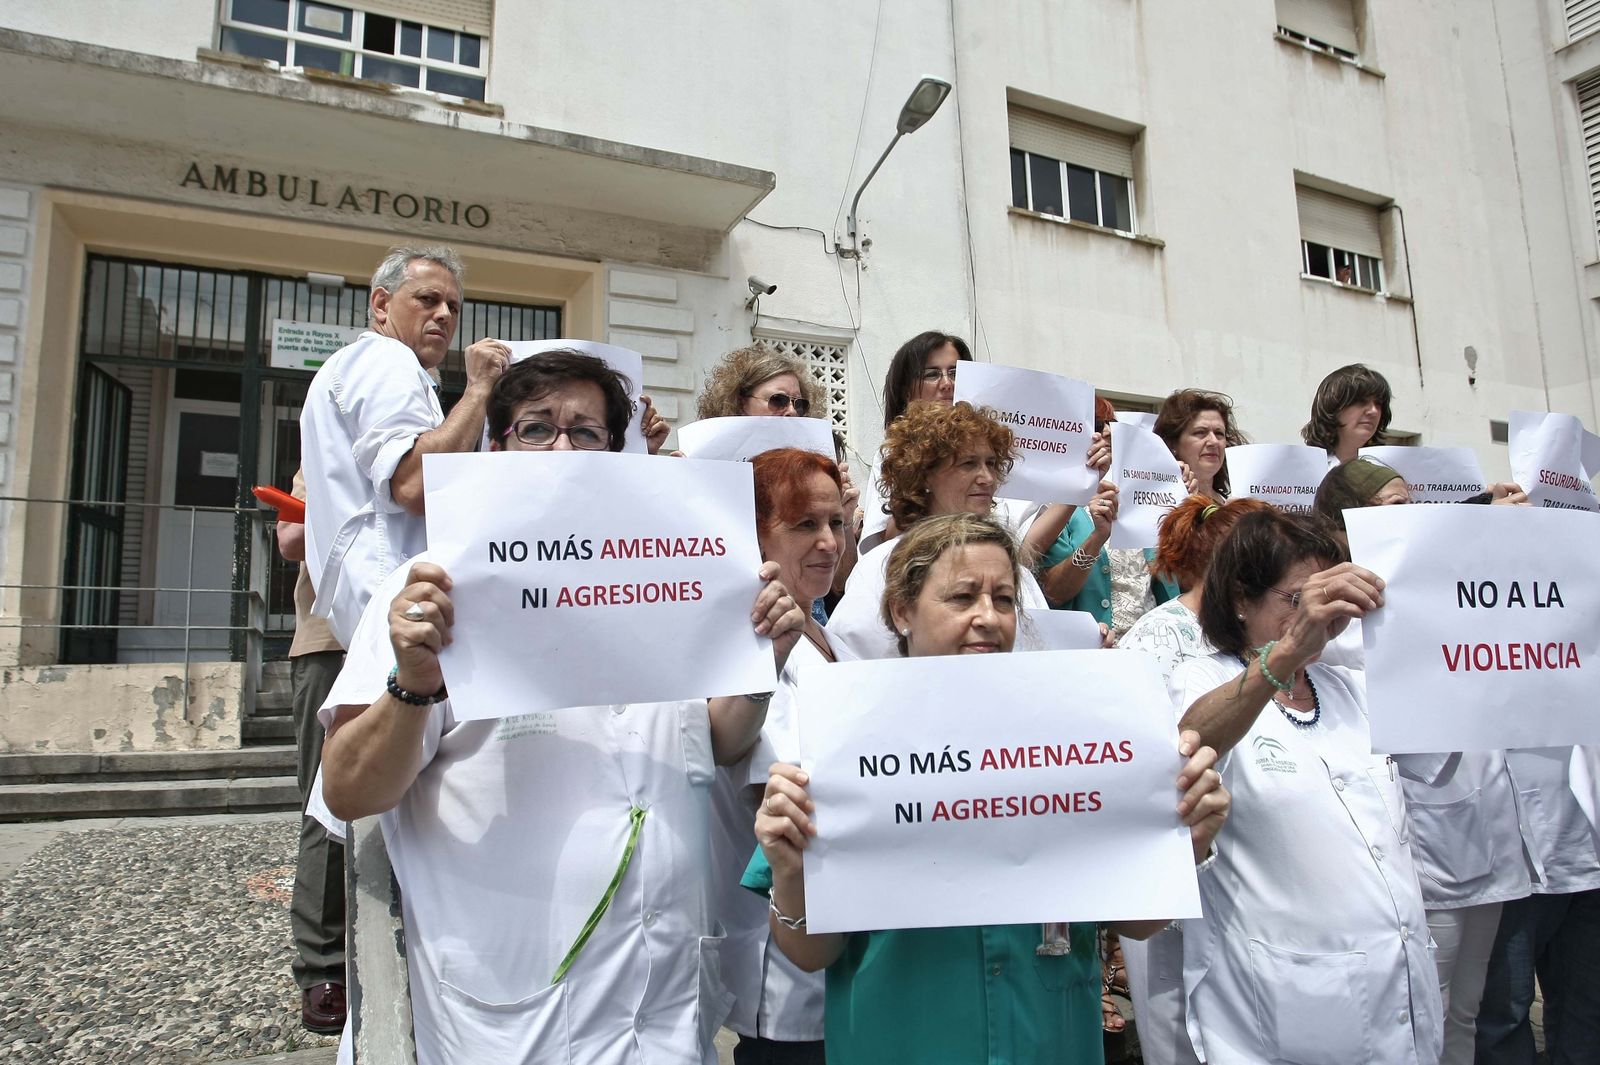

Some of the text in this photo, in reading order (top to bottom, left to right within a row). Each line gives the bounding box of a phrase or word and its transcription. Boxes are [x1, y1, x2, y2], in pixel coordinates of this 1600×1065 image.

[180, 162, 490, 228] AMBULATORIO
[278, 326, 305, 336] Entrada
[312, 330, 333, 339] Rayos
[325, 339, 343, 347] 20:00
[311, 346, 336, 355] Urgenc
[1001, 410, 1026, 425] MÁS
[1028, 415, 1083, 433] AMENAZAS
[1013, 437, 1067, 454] GRESIONES
[1123, 469, 1178, 483] EN SANIDAD TRABAJAMOS
[1133, 490, 1176, 505] PERSONAS
[1250, 485, 1316, 494] EN SANIDAD TRABAJ
[489, 534, 726, 562] NO MÁS AMENAZAS
[521, 581, 703, 609] NI AGRESIONES
[1456, 580, 1564, 608] NO A LA
[1441, 642, 1581, 671] VIOLENCIA
[859, 740, 1134, 777] NO MÁS AMENAZAS
[895, 791, 1102, 824] NI AGRESIONES
